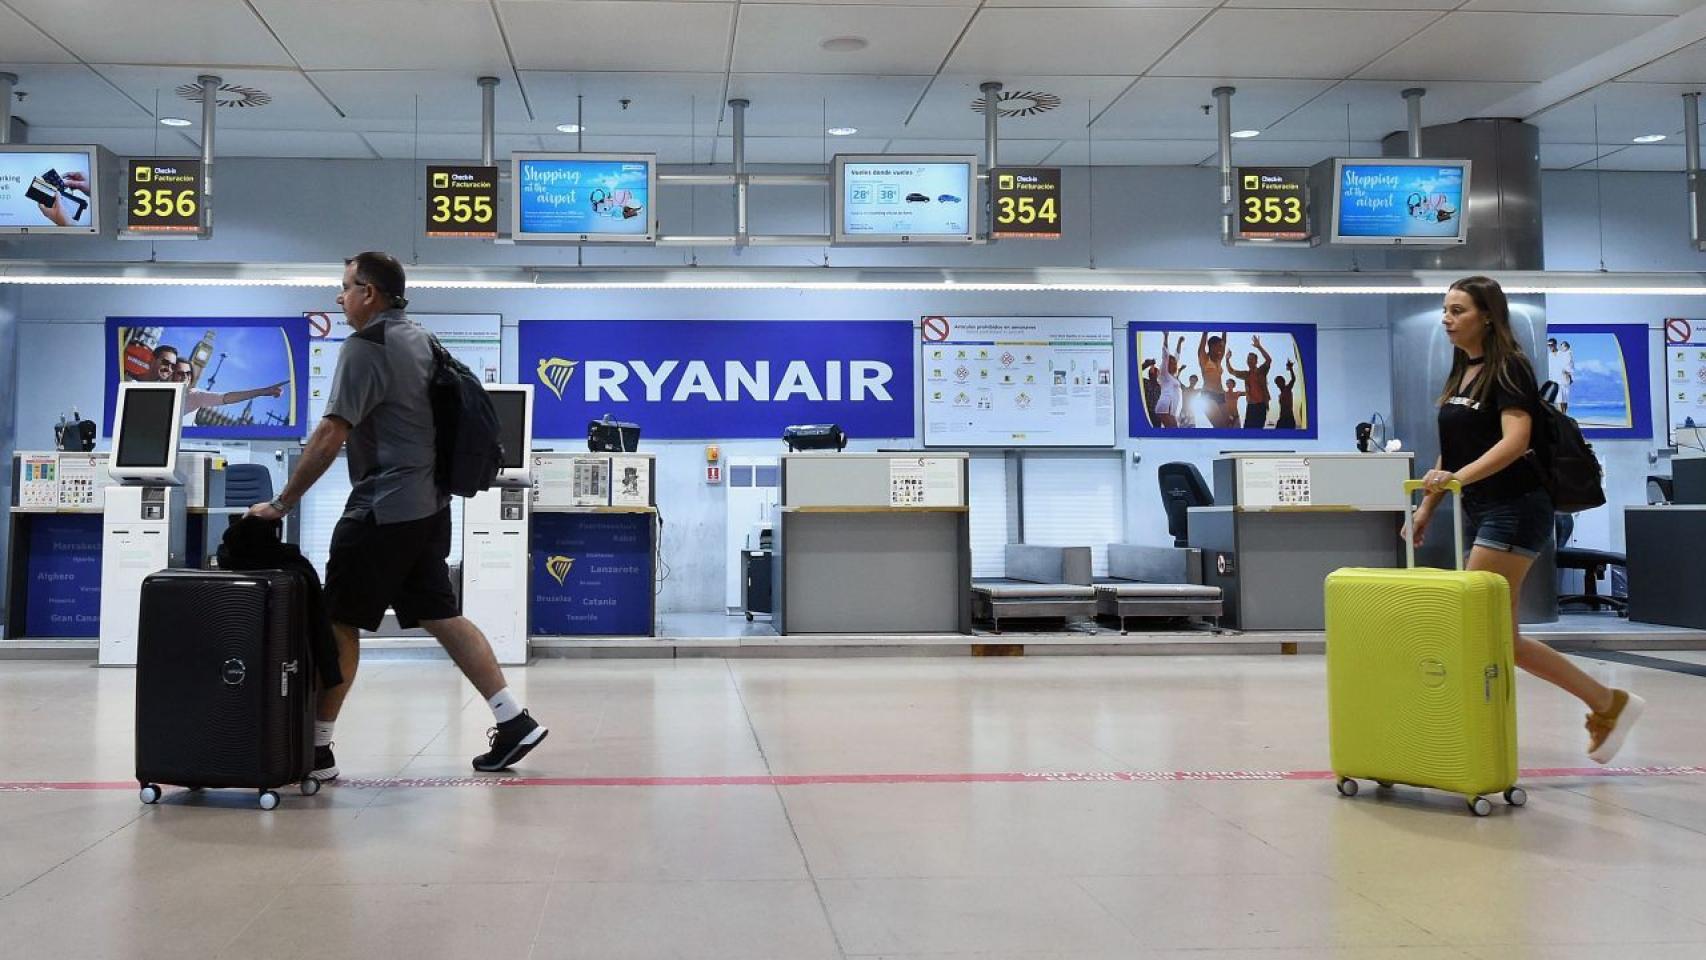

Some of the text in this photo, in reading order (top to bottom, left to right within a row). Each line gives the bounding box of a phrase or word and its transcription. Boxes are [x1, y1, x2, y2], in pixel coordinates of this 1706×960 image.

[154, 174, 194, 182] Facturación
[524, 165, 580, 184] Shopping
[1345, 170, 1399, 188] Shopping
[451, 181, 491, 189] Facturación
[1016, 182, 1055, 190] Facturación
[1261, 182, 1299, 190] Facturación
[132, 188, 196, 217] 356
[536, 189, 577, 207] airport
[1356, 192, 1393, 211] airport
[432, 195, 493, 224] 355
[997, 196, 1057, 224] 354
[1244, 196, 1302, 224] 353
[584, 360, 894, 402] RYANAIR
[38, 572, 75, 582] Alghero
[591, 565, 639, 574] Lanzarote
[582, 598, 617, 606] Catania
